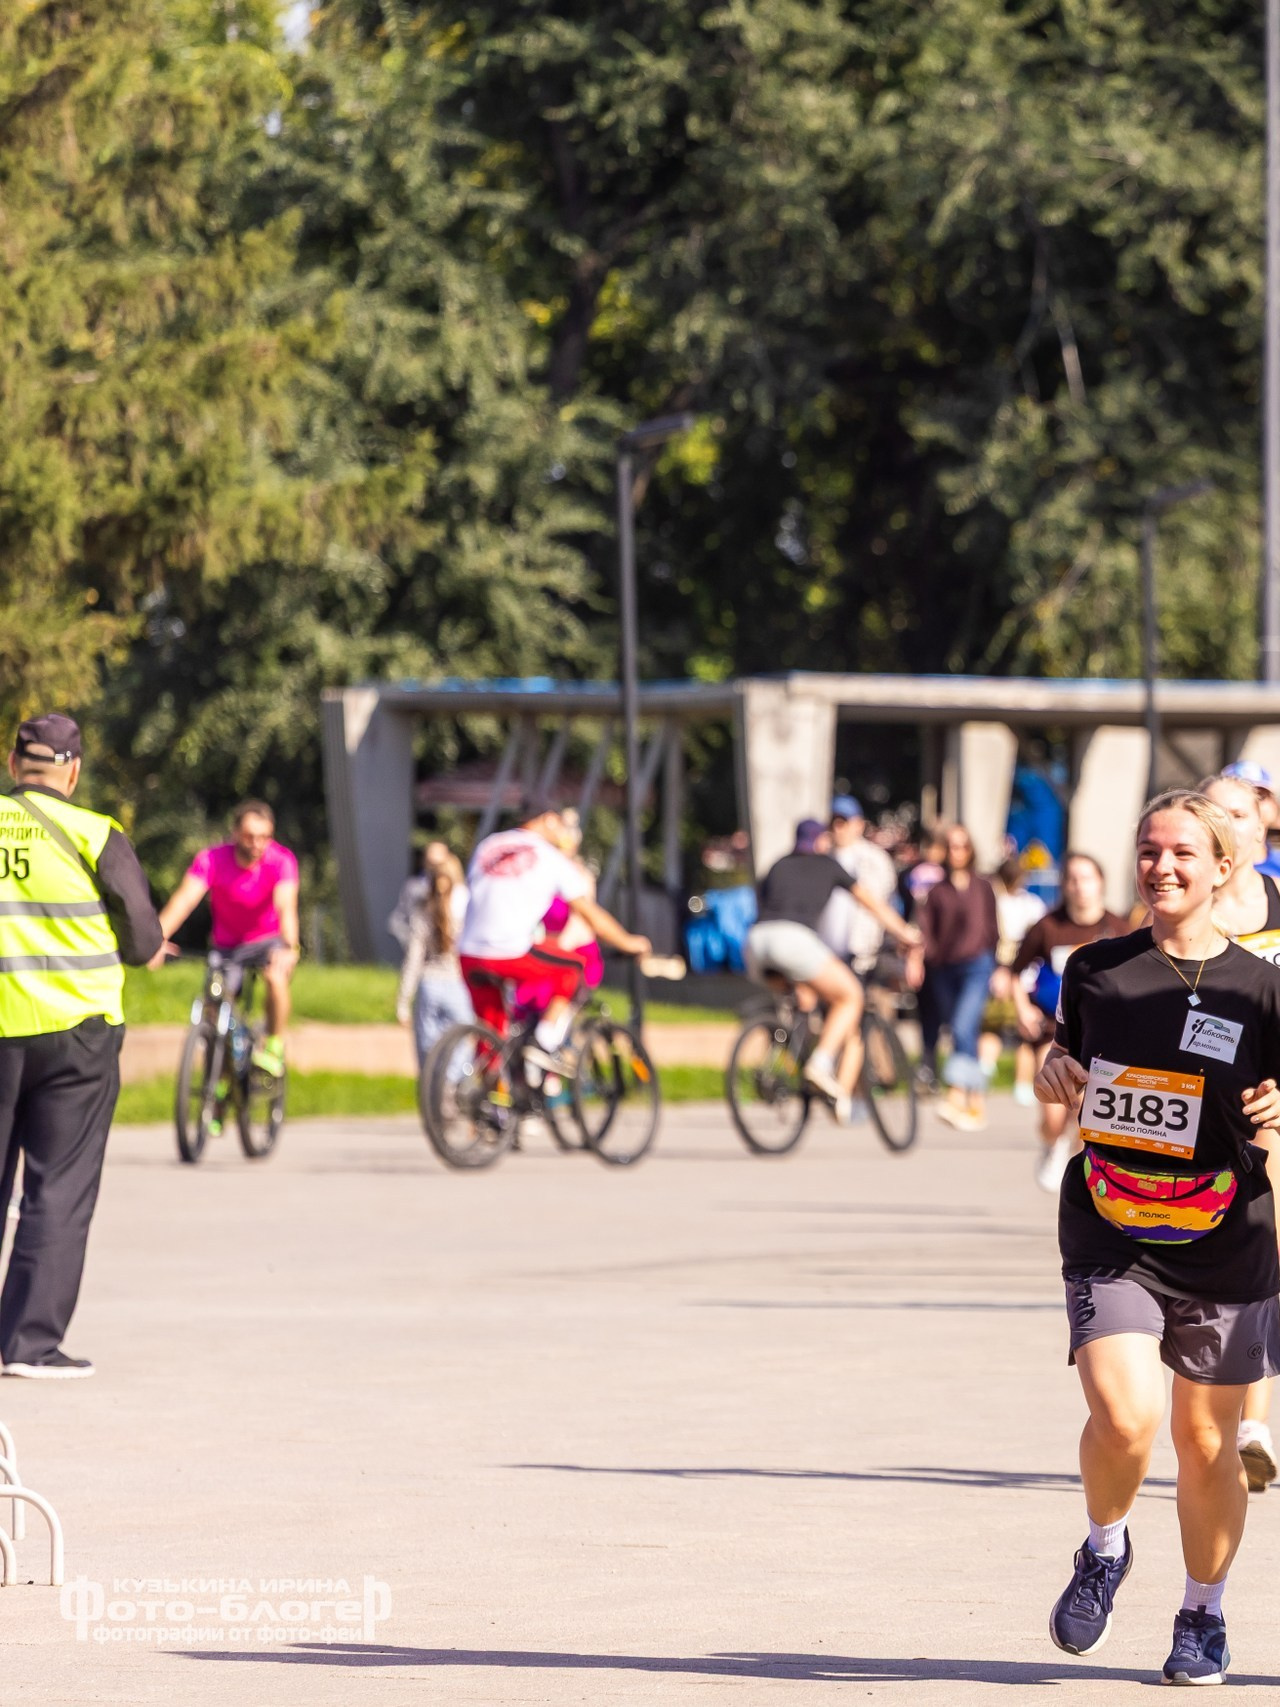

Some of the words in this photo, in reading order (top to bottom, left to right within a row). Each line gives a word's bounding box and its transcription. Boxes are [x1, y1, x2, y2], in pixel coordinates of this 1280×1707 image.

[1092, 1087, 1190, 1132] 3183
[1110, 1123, 1136, 1133] БОЙКО
[1136, 1127, 1168, 1138] ПОЛИНА
